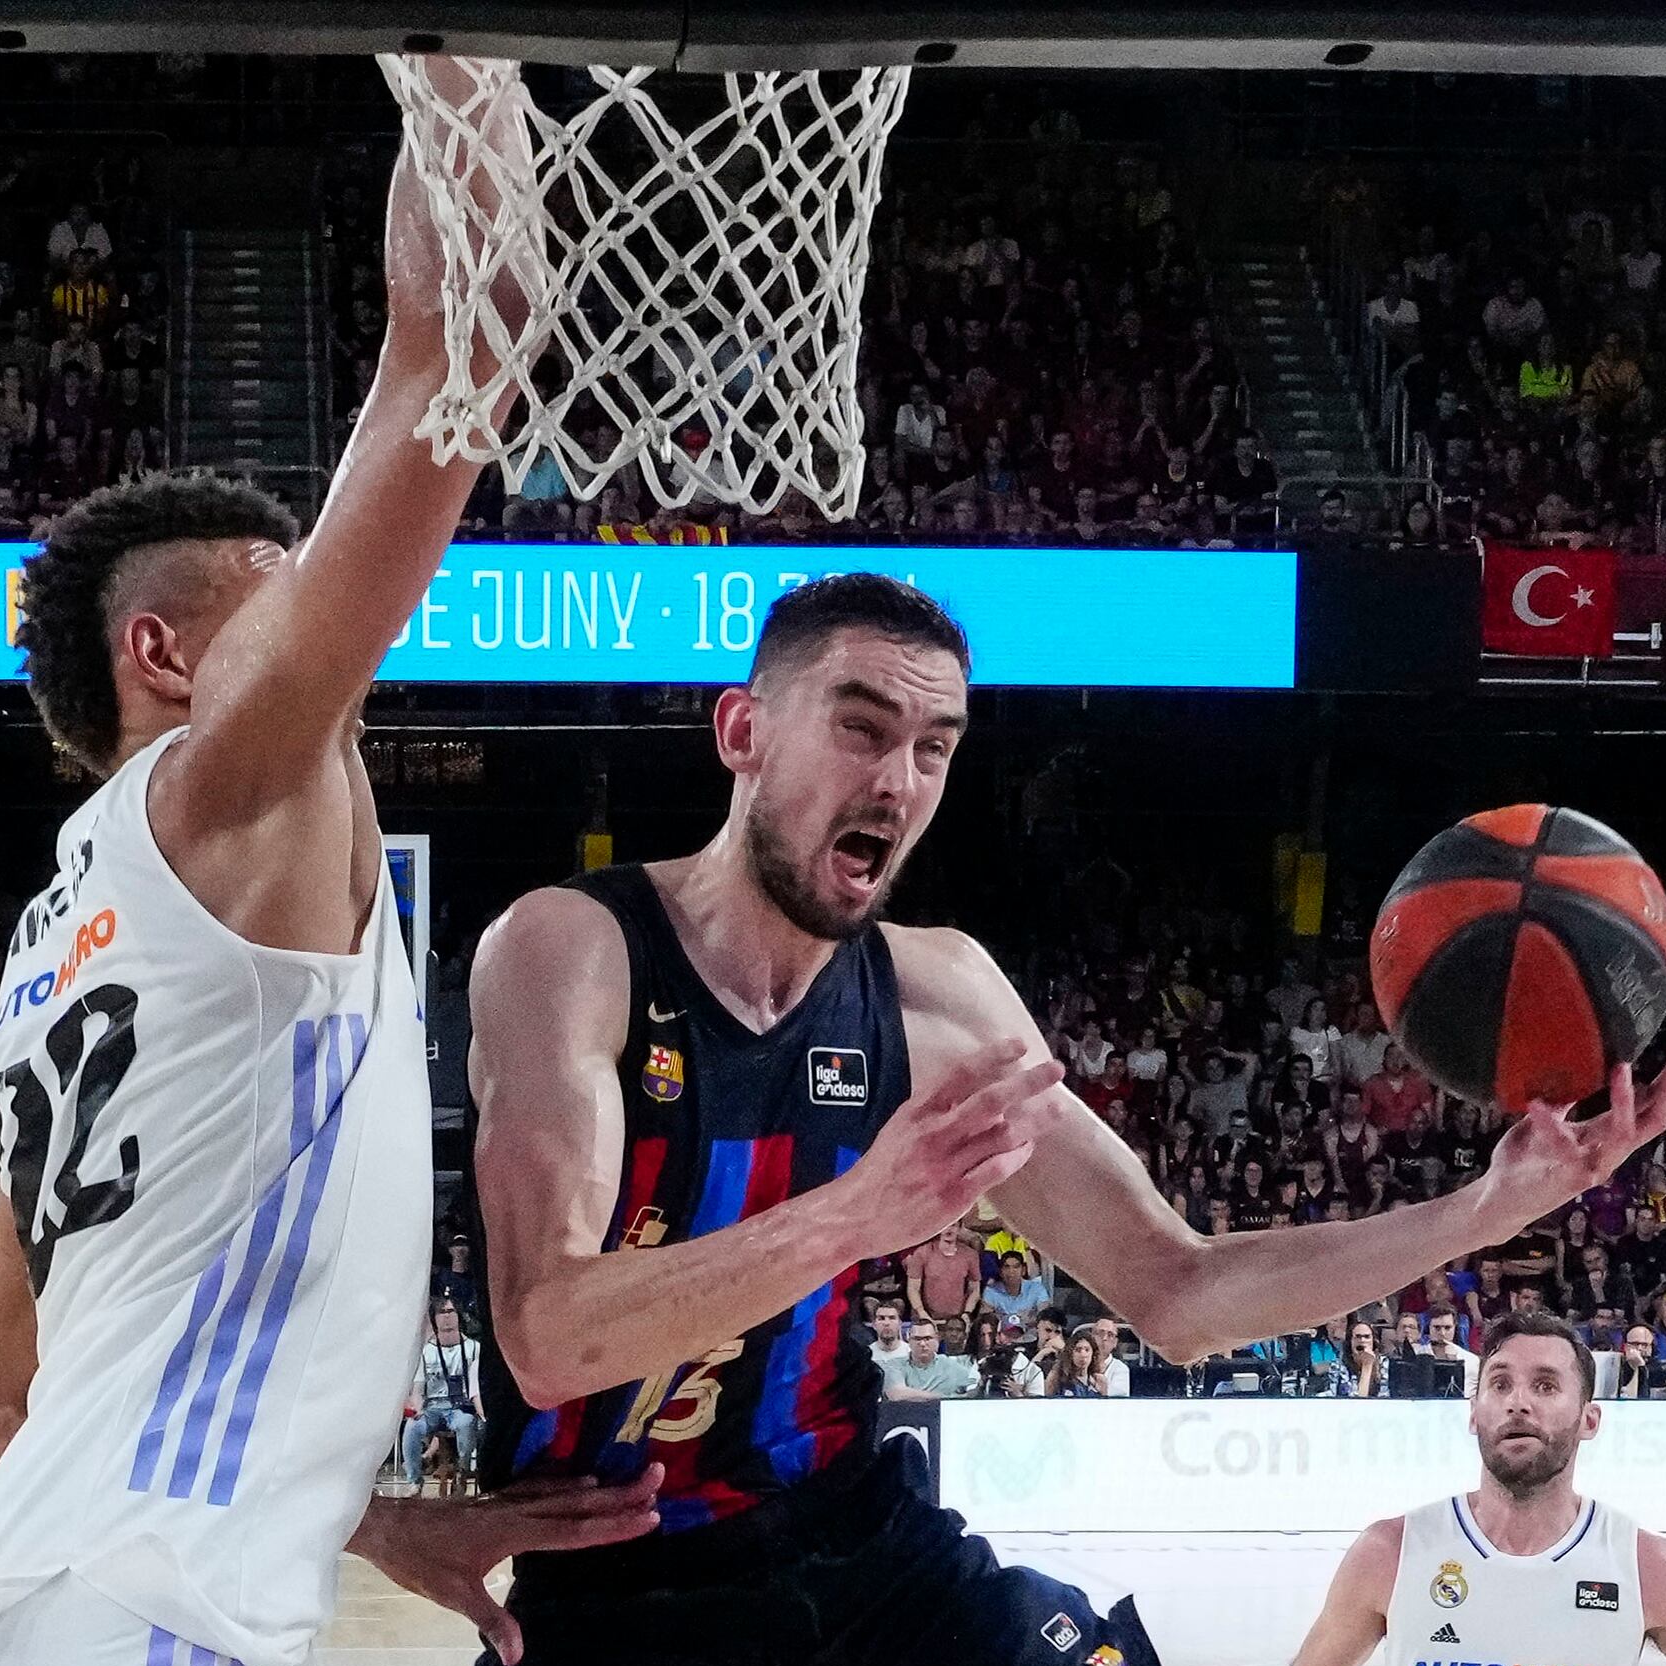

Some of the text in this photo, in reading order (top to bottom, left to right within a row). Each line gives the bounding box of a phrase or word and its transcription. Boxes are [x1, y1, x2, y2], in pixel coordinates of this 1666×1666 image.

[471, 569, 642, 650] JUNY
[816, 1065, 840, 1082] liga
[816, 1081, 866, 1099] endesa
[1160, 1411, 1310, 1477] Con
[1579, 1589, 1599, 1599] liga
[1429, 1635, 1461, 1644] adidas
